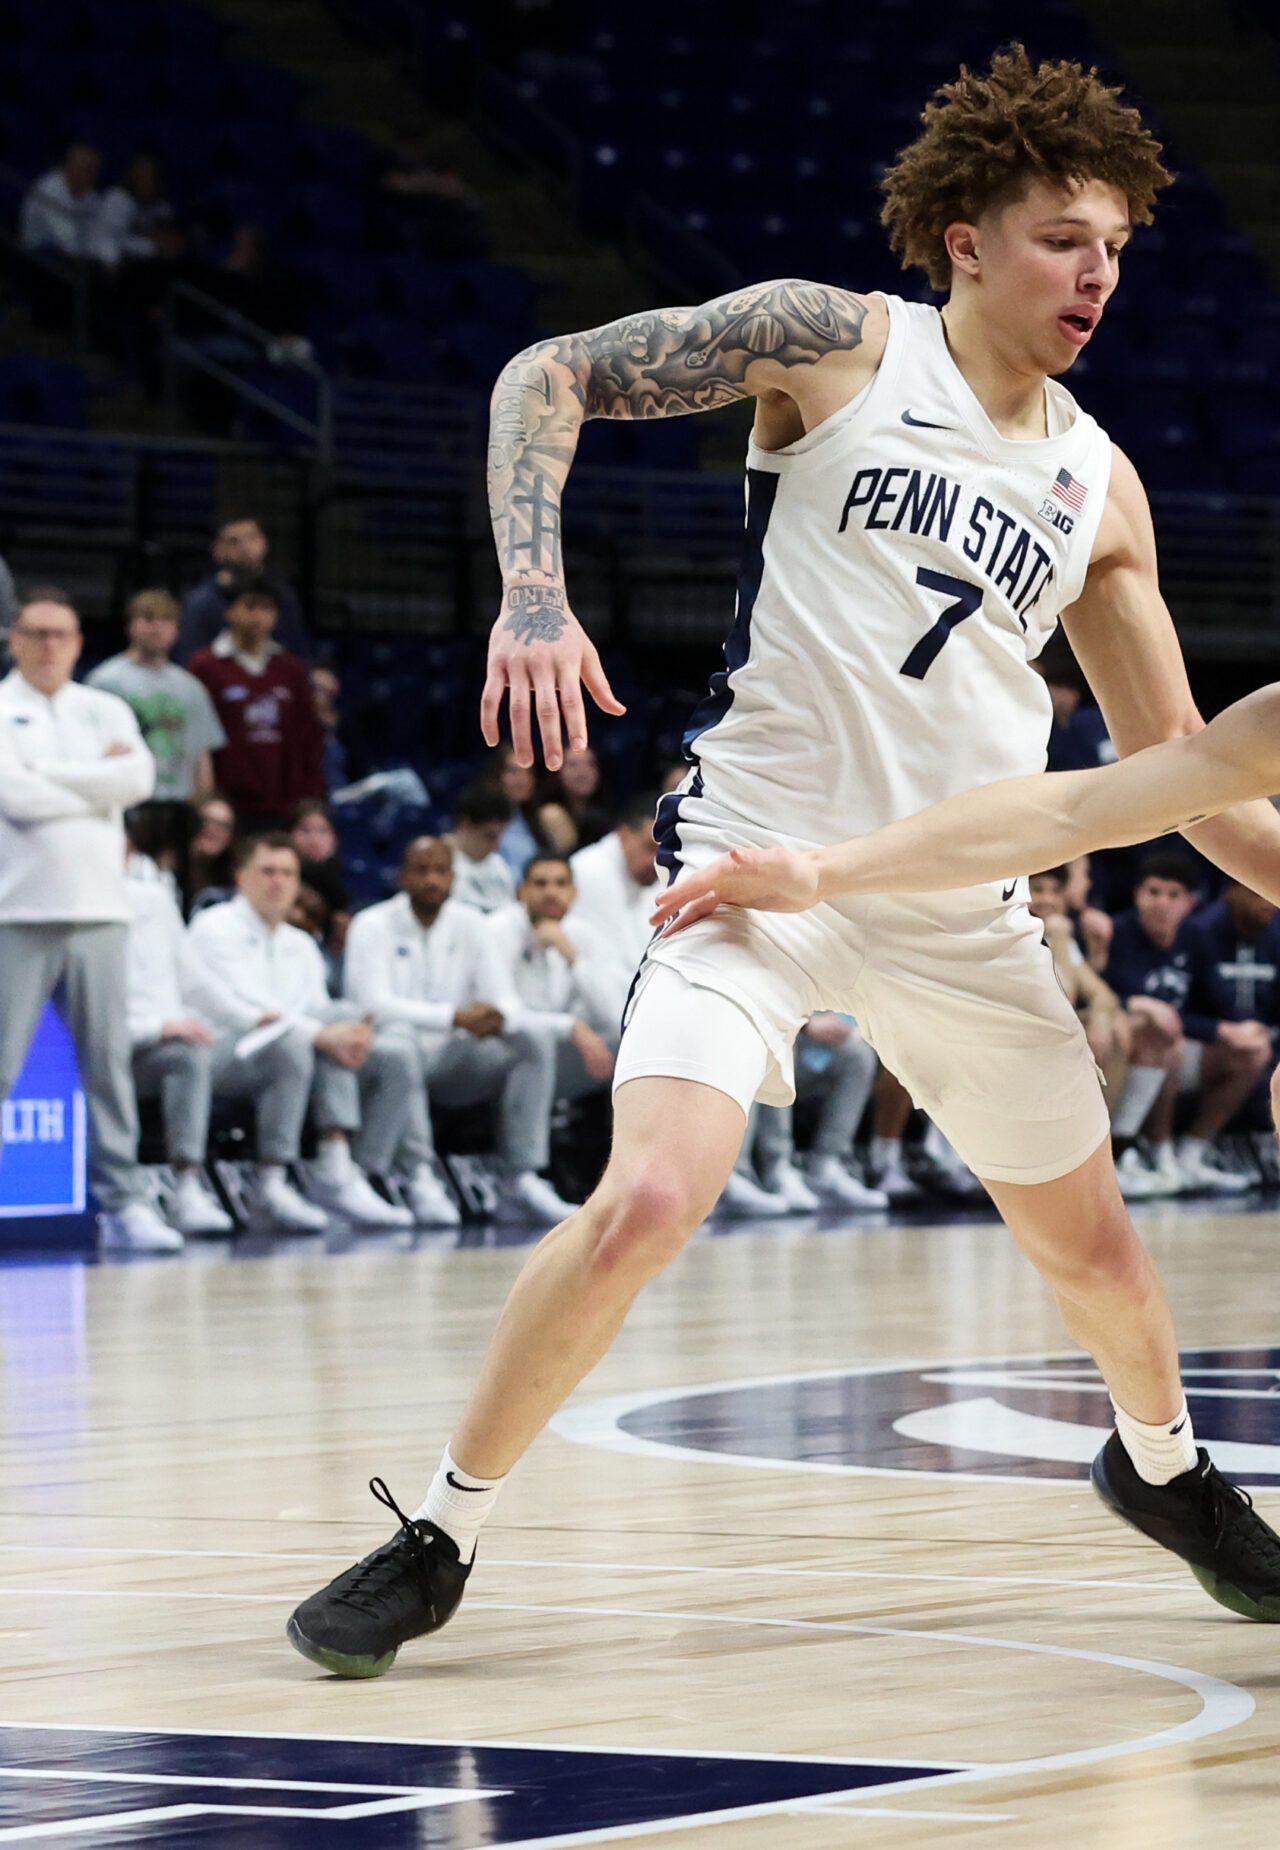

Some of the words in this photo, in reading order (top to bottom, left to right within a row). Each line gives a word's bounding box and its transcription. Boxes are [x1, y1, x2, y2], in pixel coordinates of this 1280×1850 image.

[838, 467, 961, 543] PENN
[1037, 499, 1075, 535] BIG
[899, 566, 984, 680] 7
